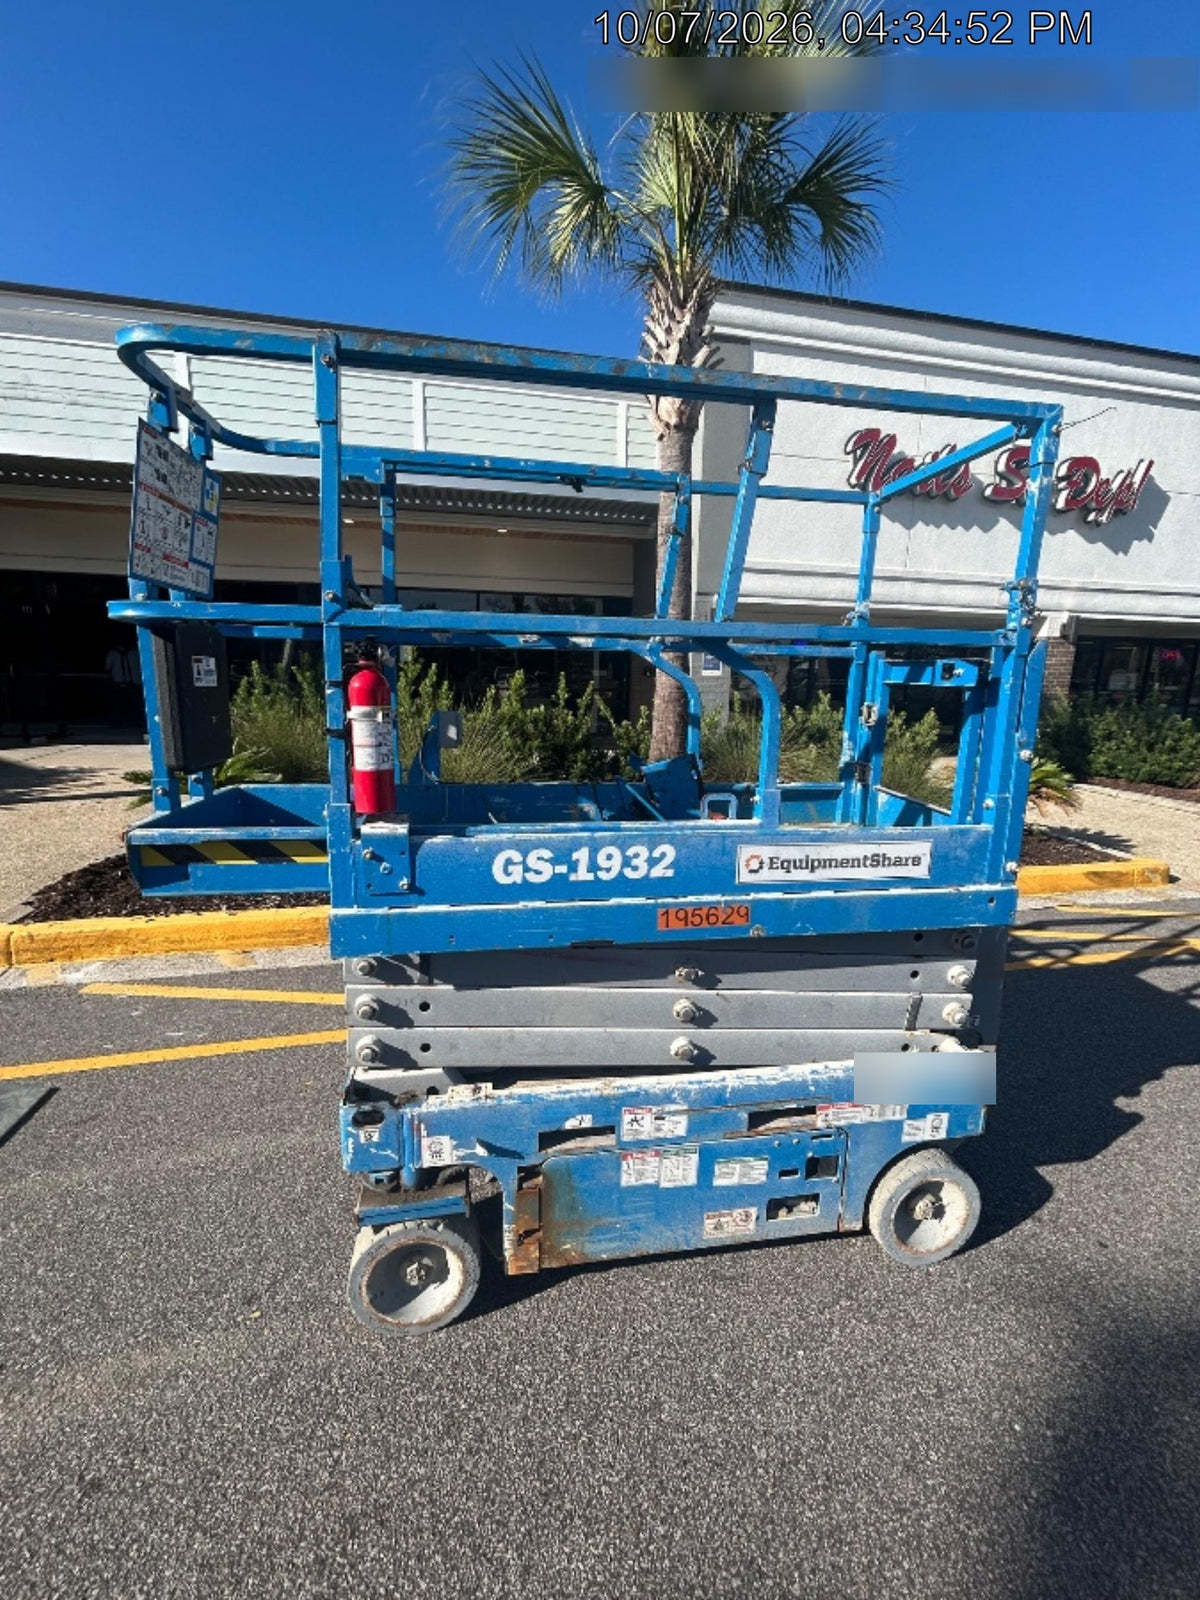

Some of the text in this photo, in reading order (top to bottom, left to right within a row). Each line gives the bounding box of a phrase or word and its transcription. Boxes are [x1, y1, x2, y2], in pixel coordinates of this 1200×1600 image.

[491, 843, 677, 885] GS-1932
[767, 852, 923, 874] EquipmentShare
[660, 904, 750, 929] 195629
